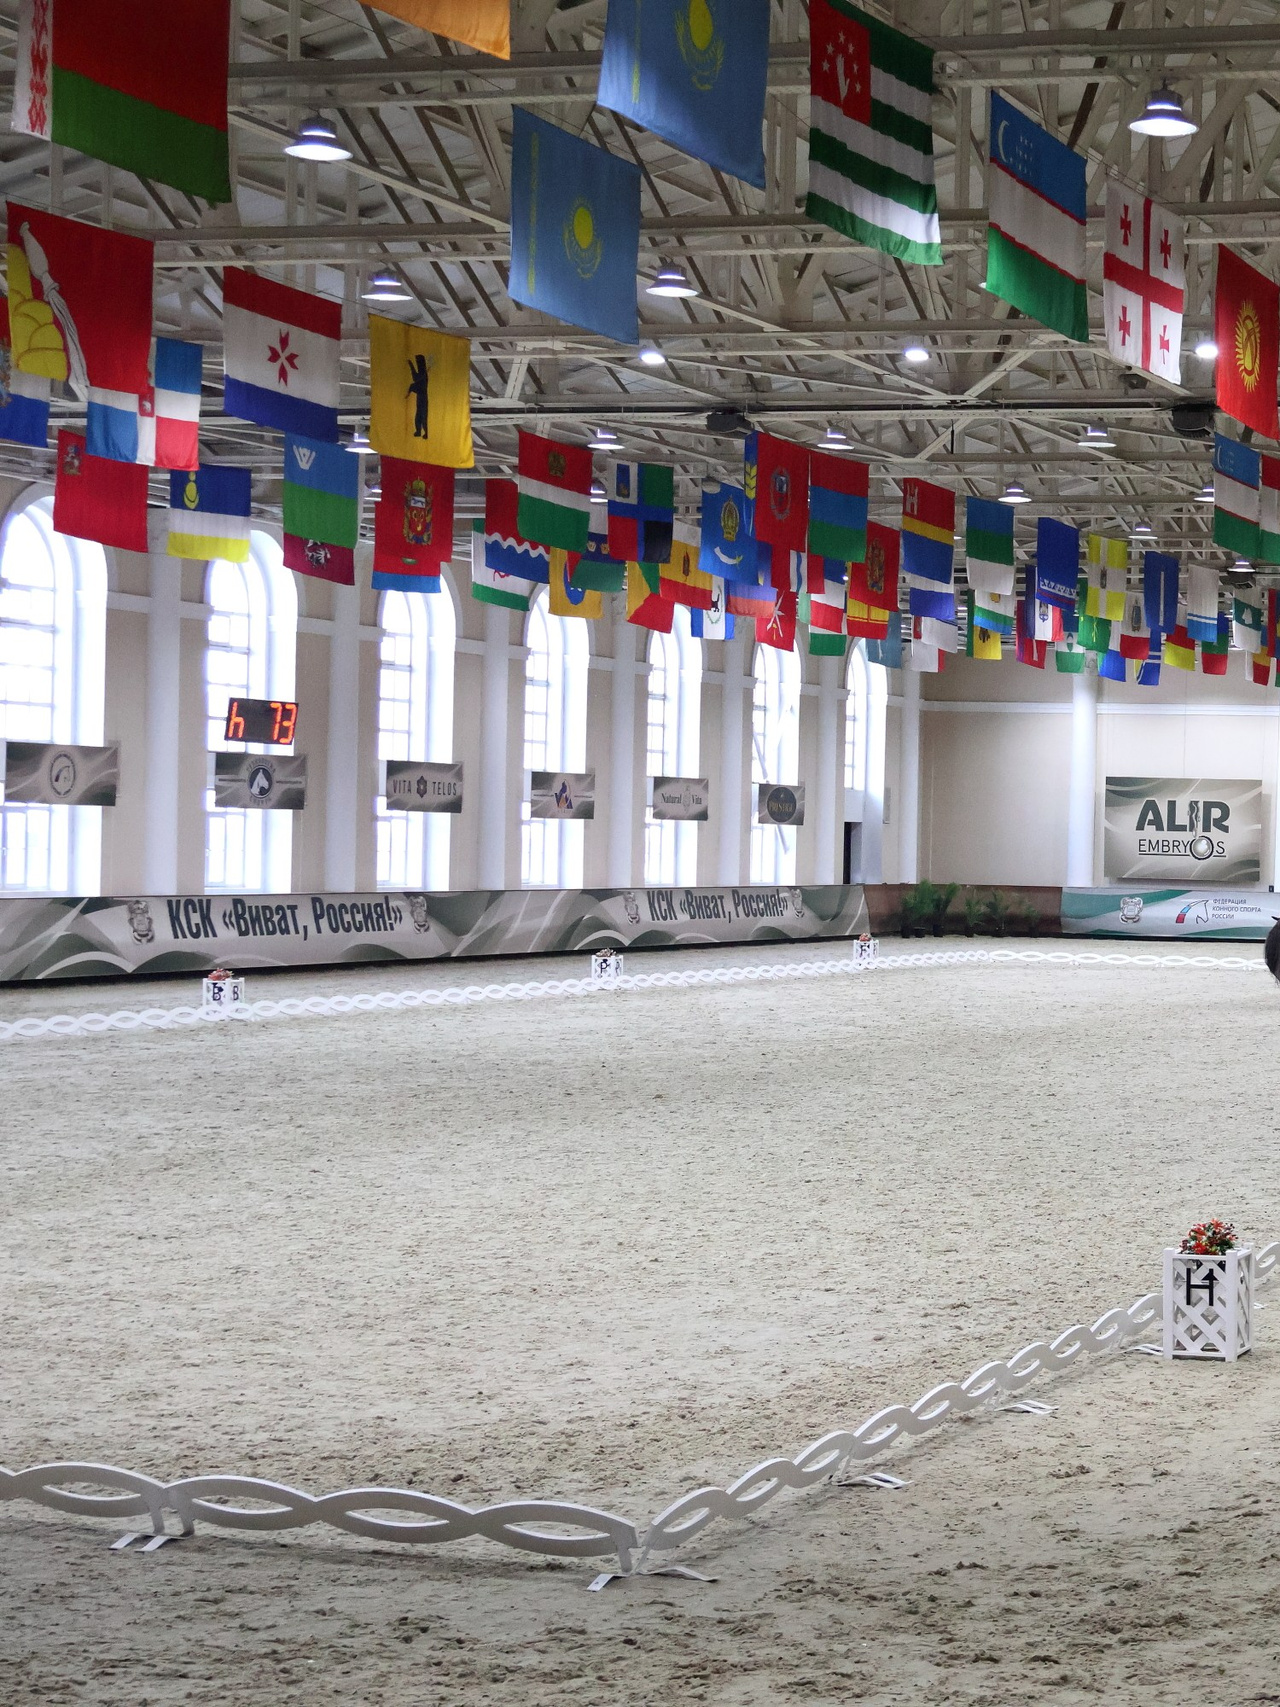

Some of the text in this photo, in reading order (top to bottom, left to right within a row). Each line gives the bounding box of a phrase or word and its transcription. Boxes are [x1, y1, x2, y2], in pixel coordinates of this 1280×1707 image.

[270, 702, 297, 744] 73
[393, 779, 457, 796] VITA TELOS
[1136, 799, 1230, 834] ALIR
[1138, 836, 1226, 860] EMBRYOS
[167, 895, 403, 941] КСК «Виват, Россия!»
[646, 889, 788, 923] КСК «Виват, Россия!»
[1186, 1267, 1214, 1307] H
